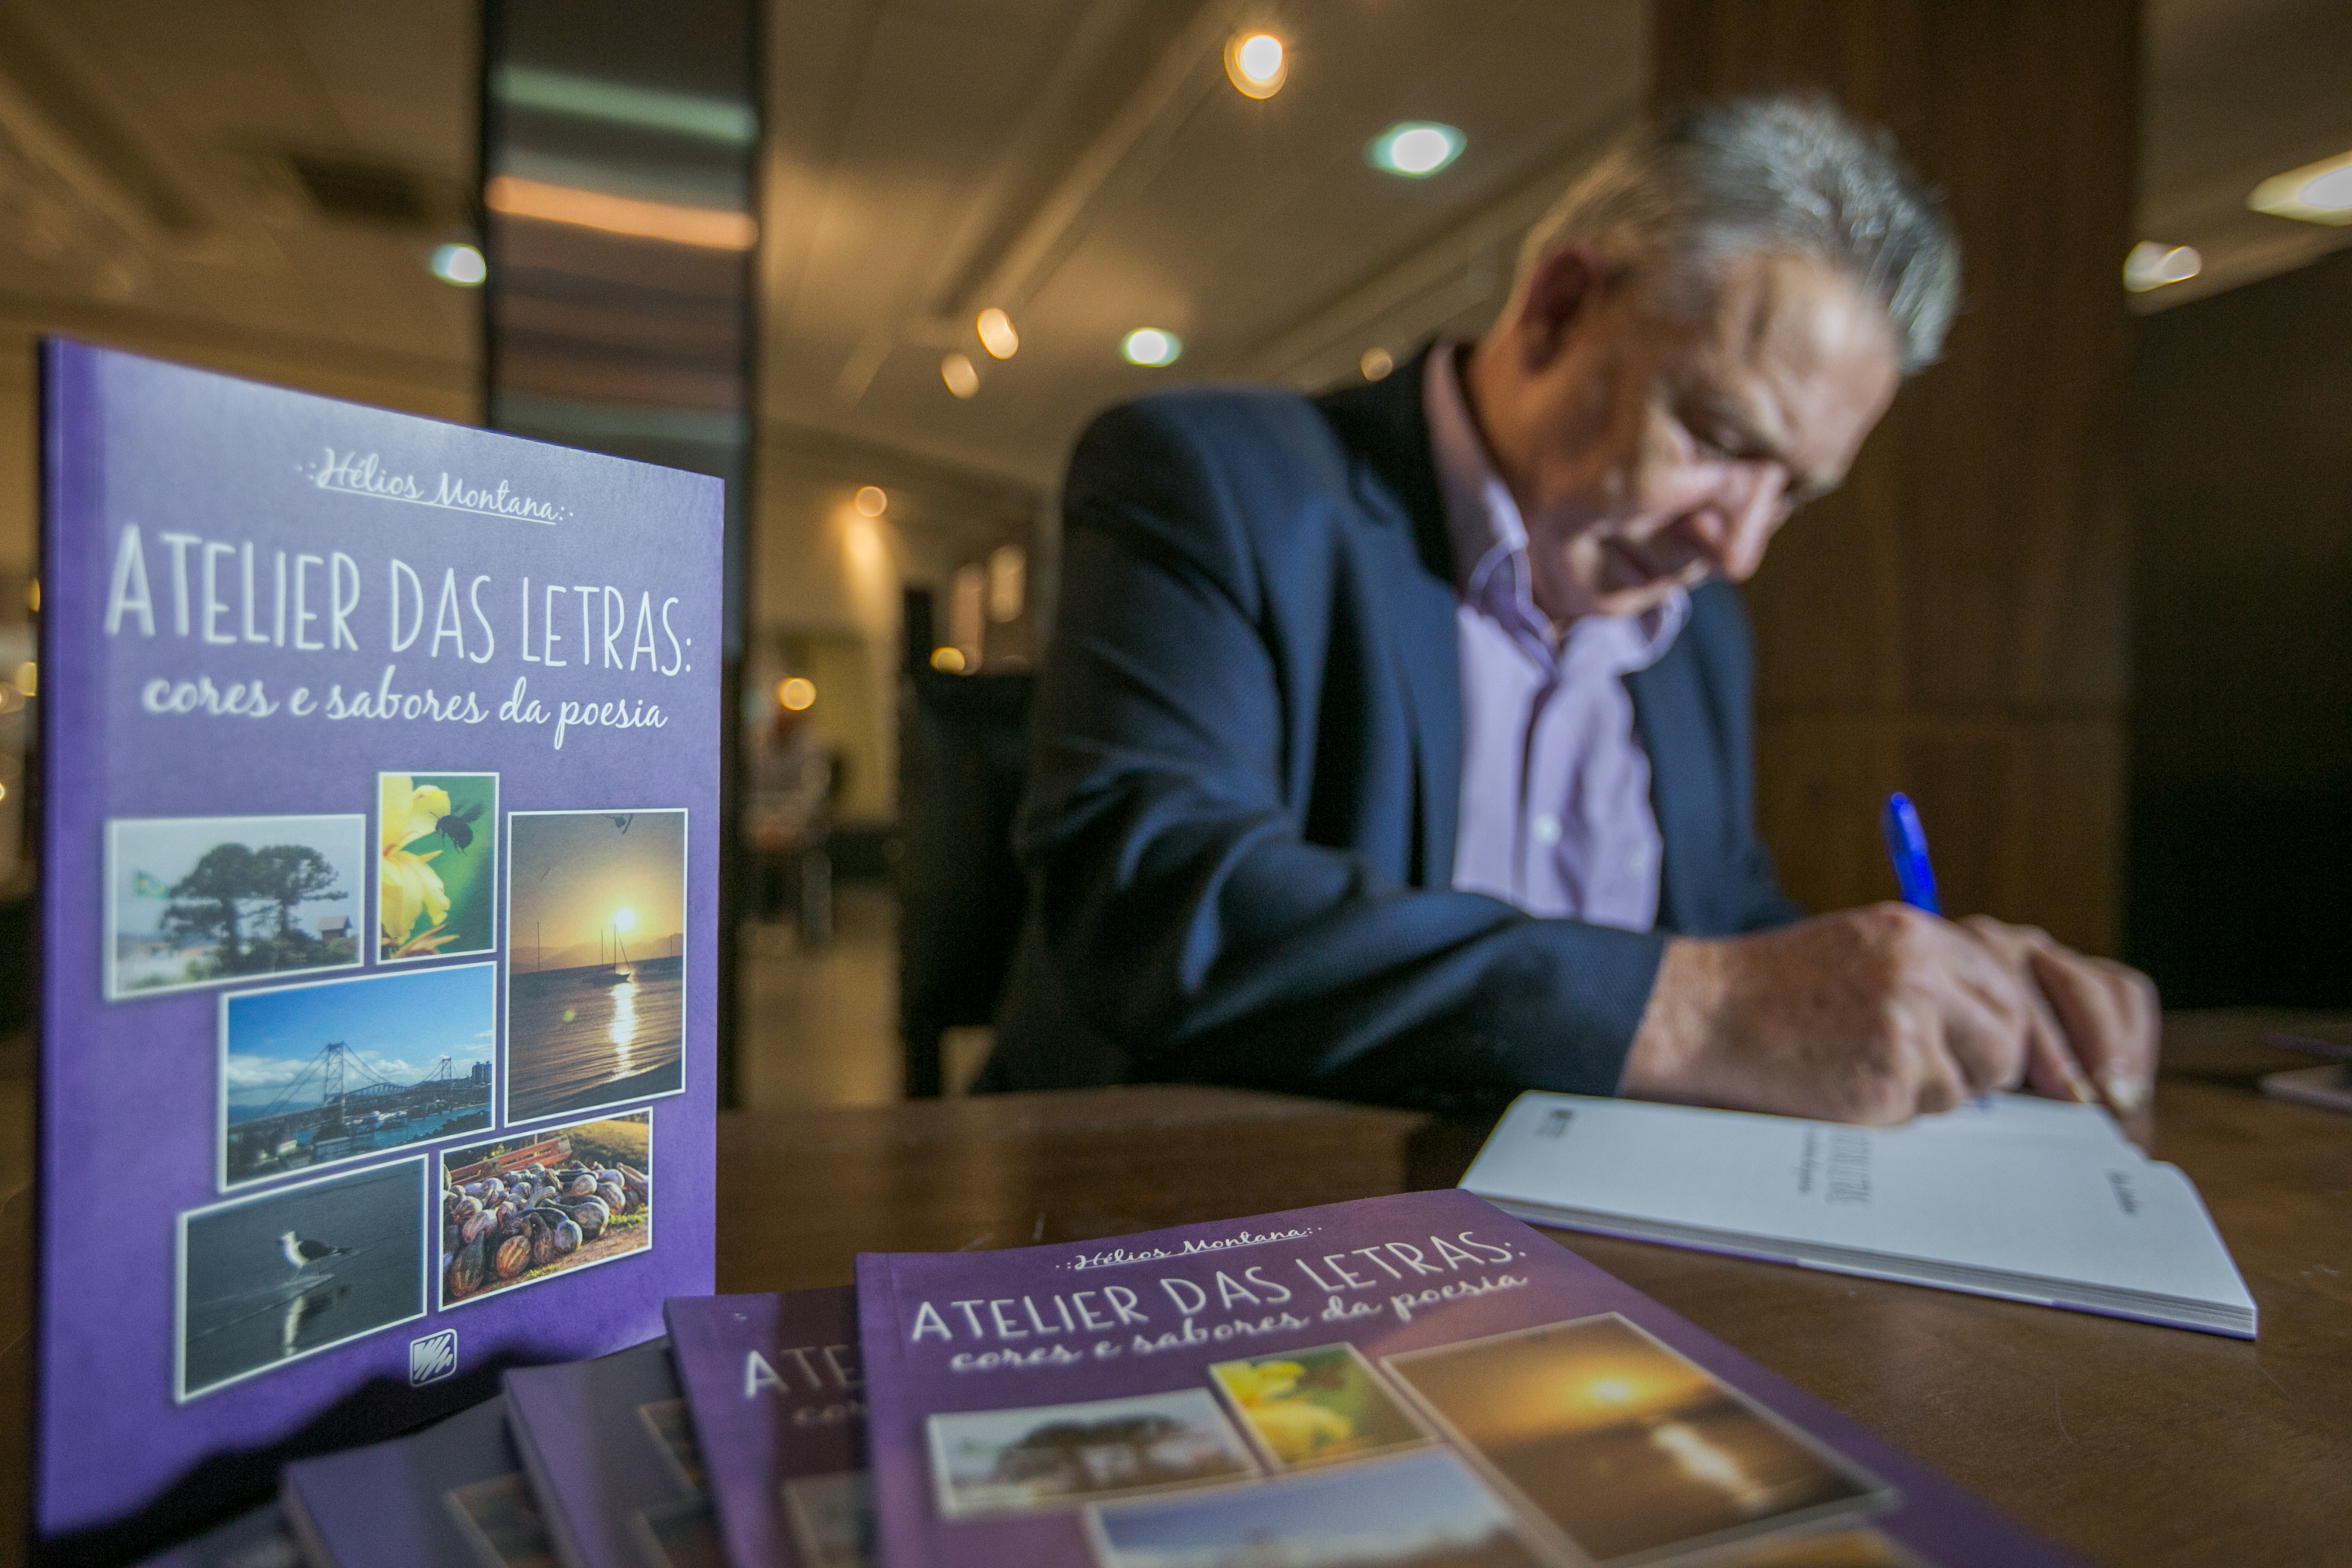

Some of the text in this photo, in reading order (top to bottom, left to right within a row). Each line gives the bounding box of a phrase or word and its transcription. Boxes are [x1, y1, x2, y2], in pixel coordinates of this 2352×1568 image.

[104, 523, 693, 677] ATELIER DAS LETRAS:
[141, 664, 668, 751] cores e sabores da poesia
[911, 1231, 1527, 1342] ATELIER DAS LETRAS:
[950, 1273, 1529, 1372] cores e sabores da poesia
